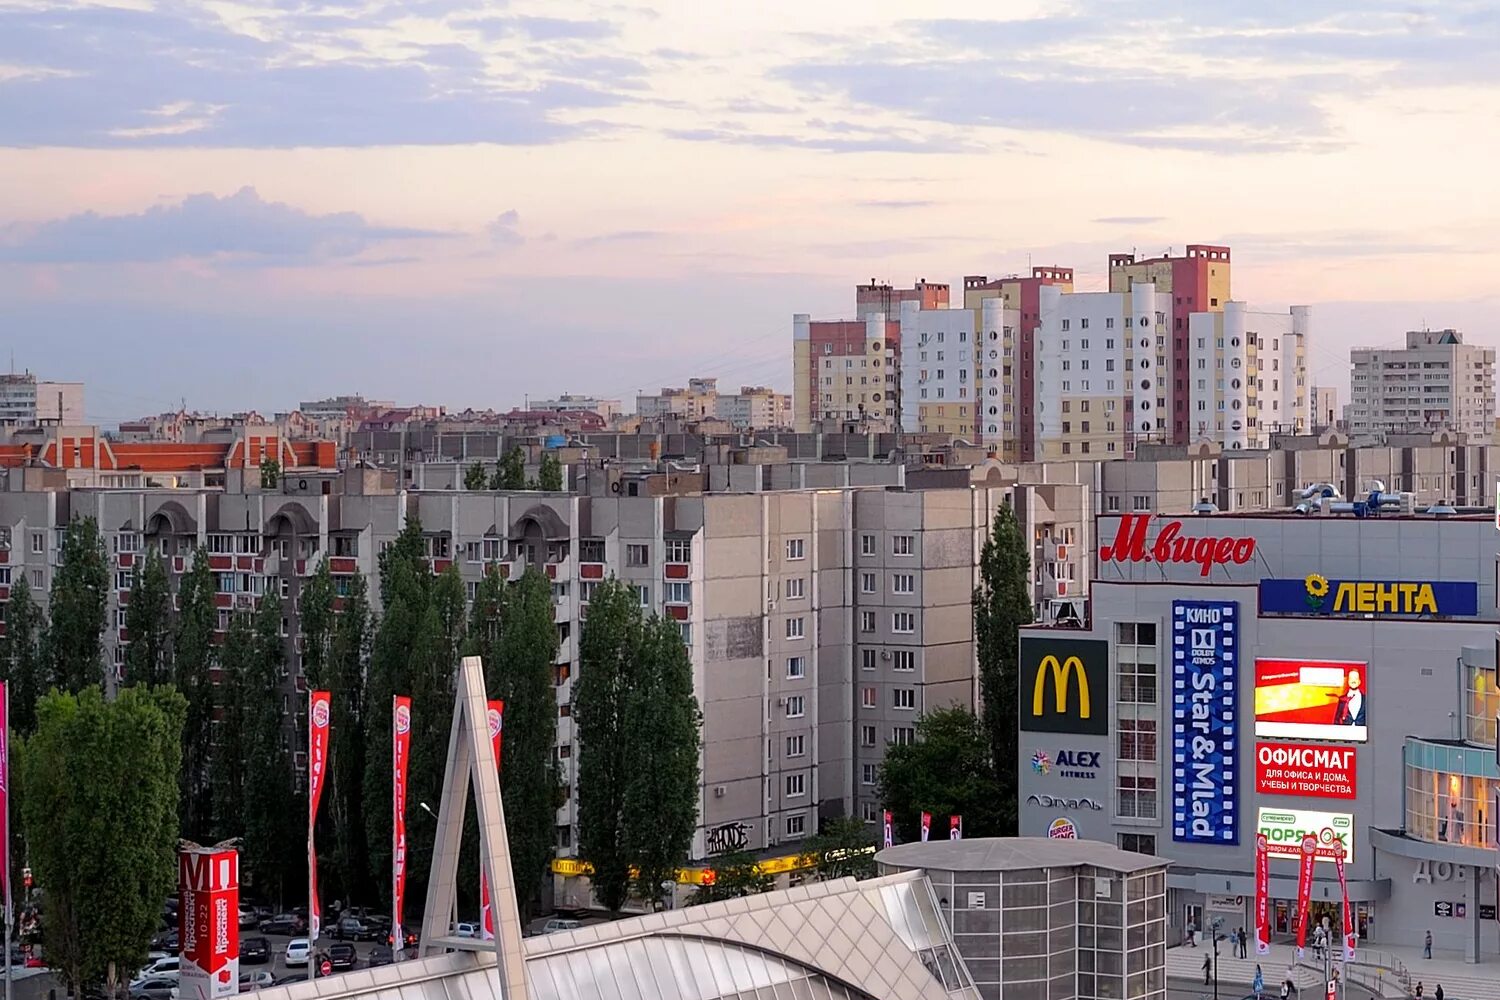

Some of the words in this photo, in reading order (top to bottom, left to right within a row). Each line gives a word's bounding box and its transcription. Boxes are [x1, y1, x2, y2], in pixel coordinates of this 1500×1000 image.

[1100, 514, 1256, 577] М.видео
[1333, 582, 1438, 613] ЛЕНТА
[1186, 608, 1221, 624] КИНО
[1056, 750, 1100, 768] ALEX
[1191, 672, 1217, 838] Star&Mlad
[1259, 747, 1354, 769] ОФИСМАГ
[1261, 780, 1289, 789] УЧЕБЫ
[1299, 782, 1352, 793] ТВОРЧЕСТВА
[1266, 769, 1282, 778] ДЛЯ
[1284, 770, 1313, 779] ОФИСА
[1323, 773, 1349, 783] ДОМА,
[200, 904, 208, 938] 10-22
